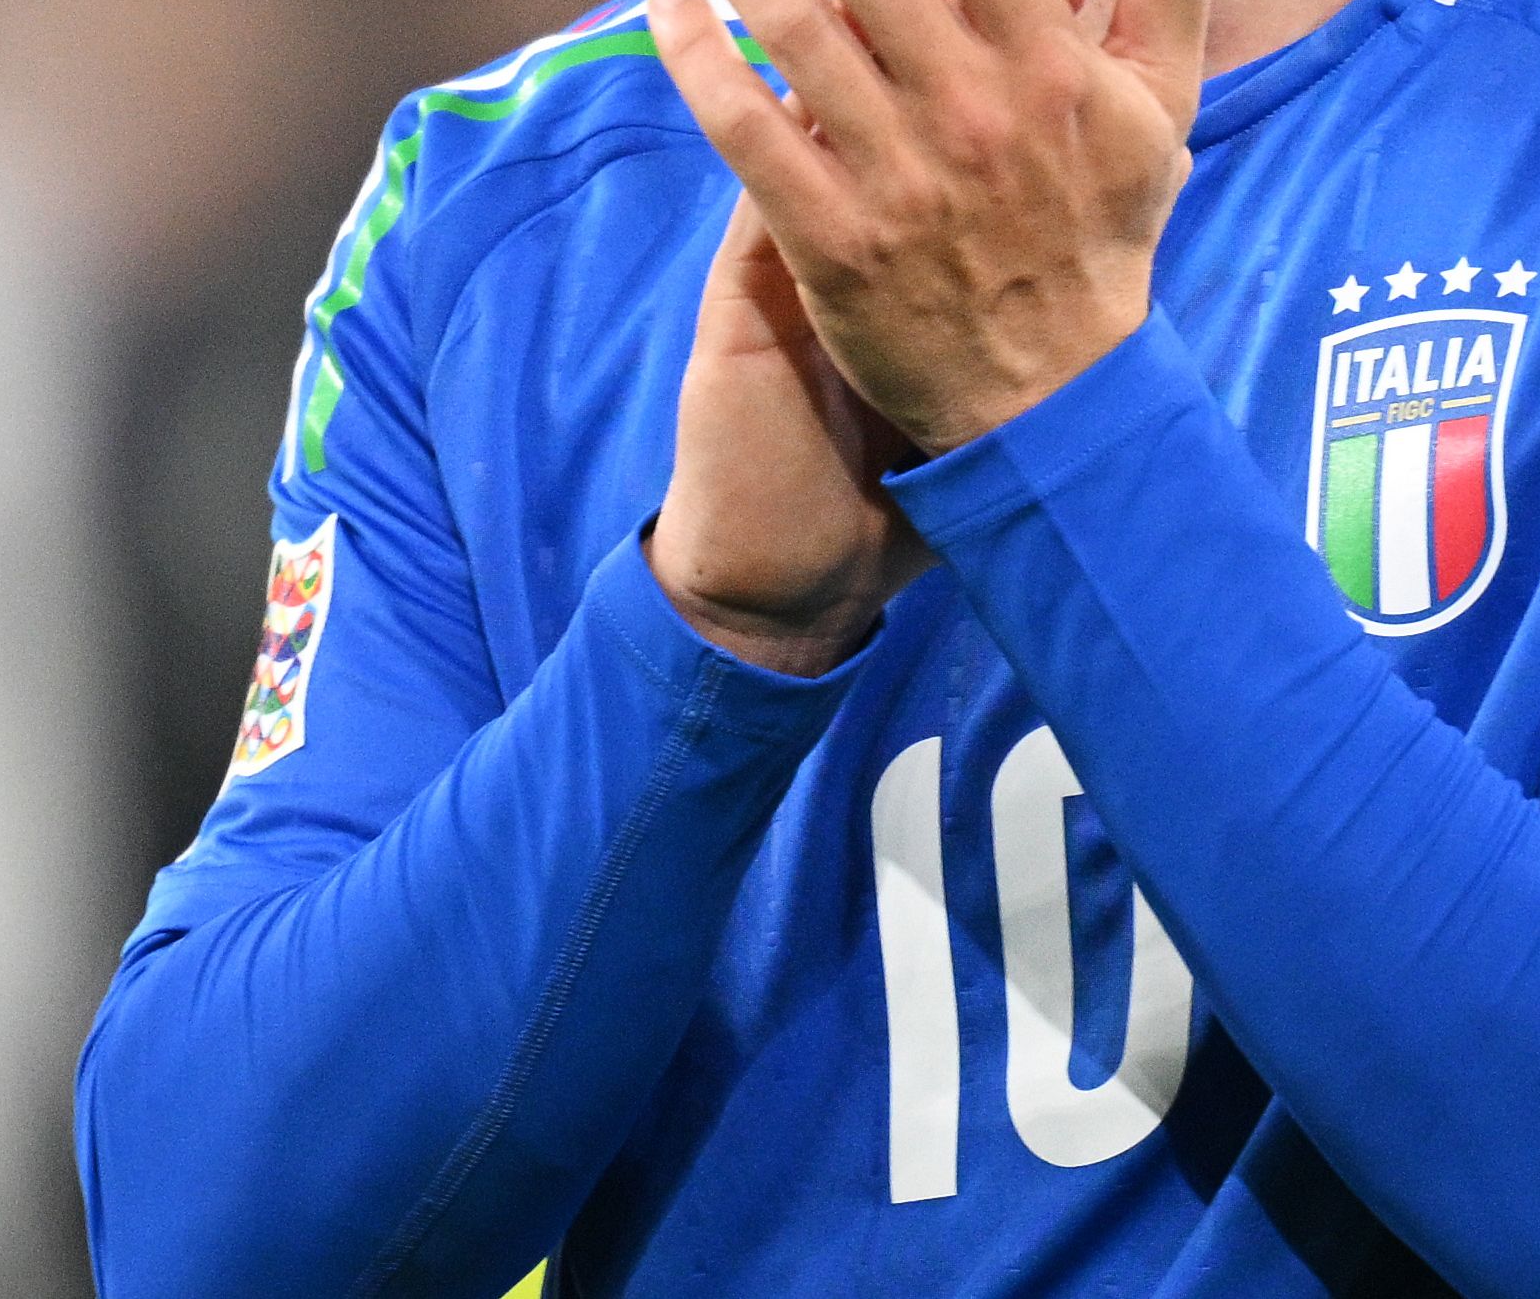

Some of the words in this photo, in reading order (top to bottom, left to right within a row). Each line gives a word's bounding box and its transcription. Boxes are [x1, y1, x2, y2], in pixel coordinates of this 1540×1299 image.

[1332, 334, 1497, 408] ITALIA
[1386, 397, 1436, 424] FIGC
[871, 724, 1194, 1205] 10
